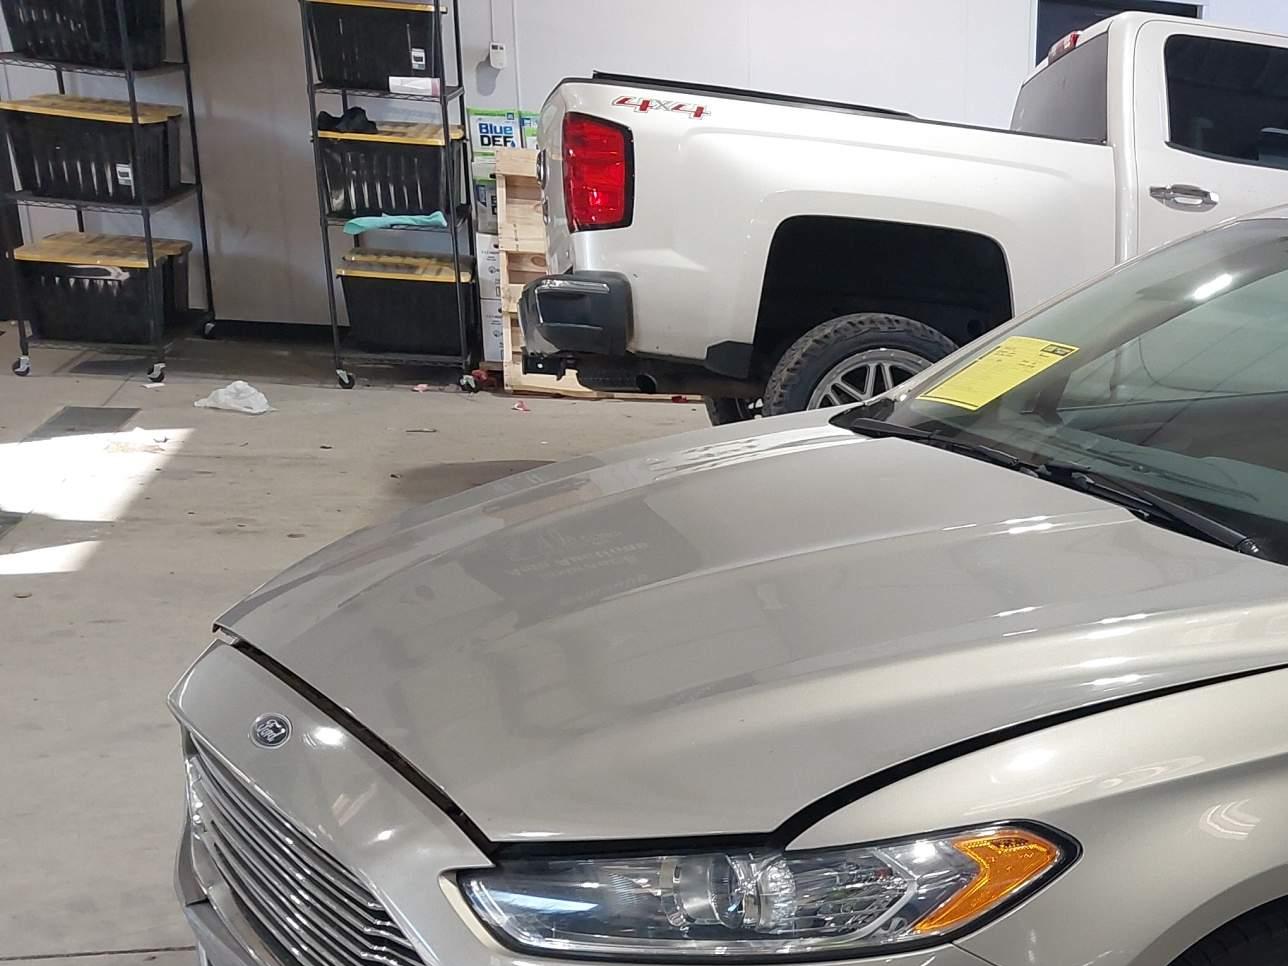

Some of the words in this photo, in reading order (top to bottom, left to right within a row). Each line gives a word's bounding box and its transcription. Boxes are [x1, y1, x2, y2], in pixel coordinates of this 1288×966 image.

[478, 122, 513, 135] Blue
[480, 135, 514, 148] DEF
[256, 719, 286, 742] Ford
